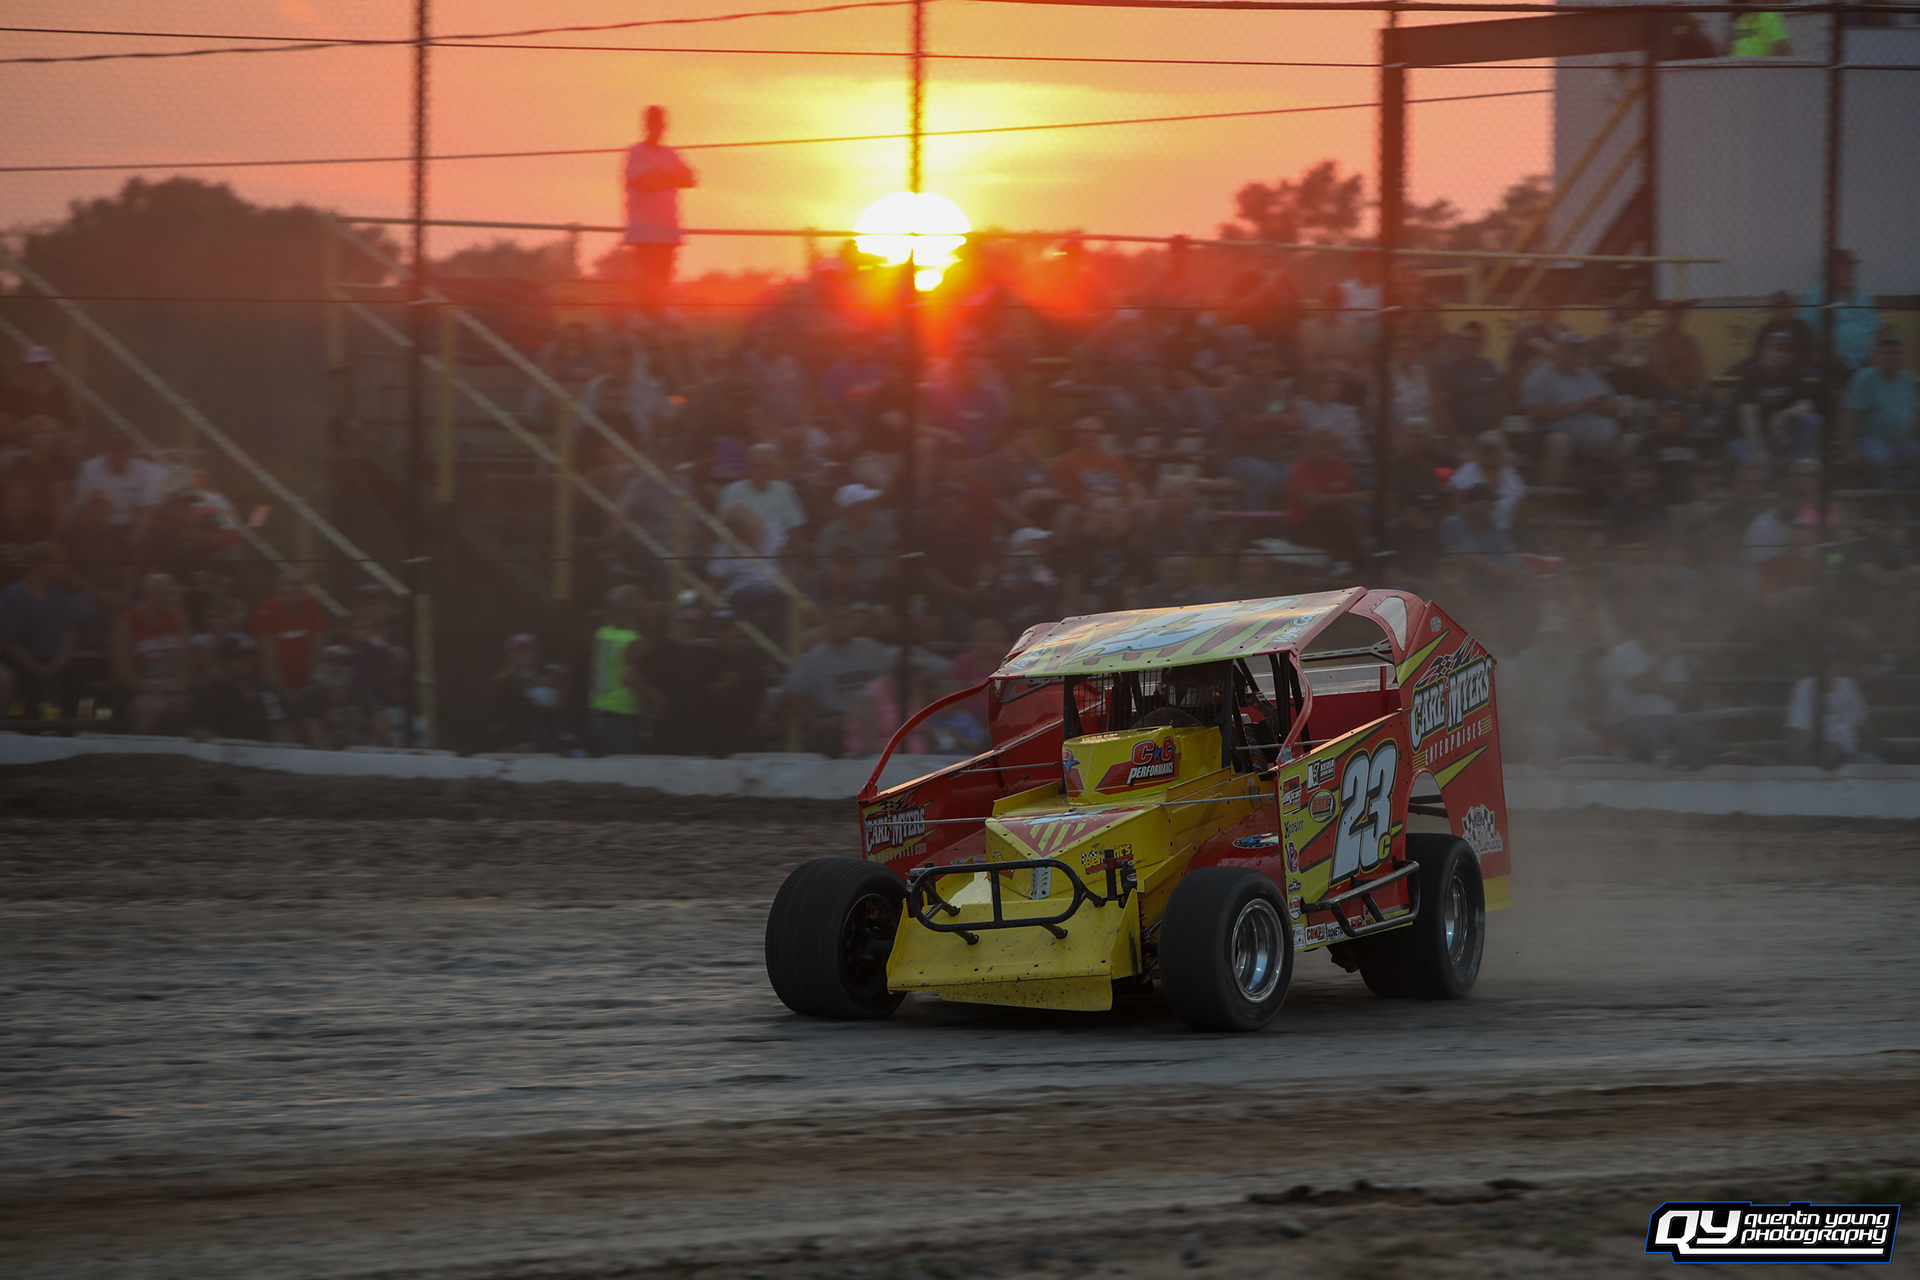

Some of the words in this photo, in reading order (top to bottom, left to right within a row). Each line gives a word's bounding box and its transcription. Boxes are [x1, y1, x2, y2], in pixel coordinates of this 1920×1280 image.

[1411, 682, 1446, 749] CARL
[1447, 656, 1493, 729] MYERS
[1424, 719, 1483, 766] ENTERPRISES
[1127, 762, 1174, 786] PERFORMANCE
[866, 815, 890, 852] CARL
[892, 808, 925, 846] MYERS
[1331, 743, 1398, 882] 23
